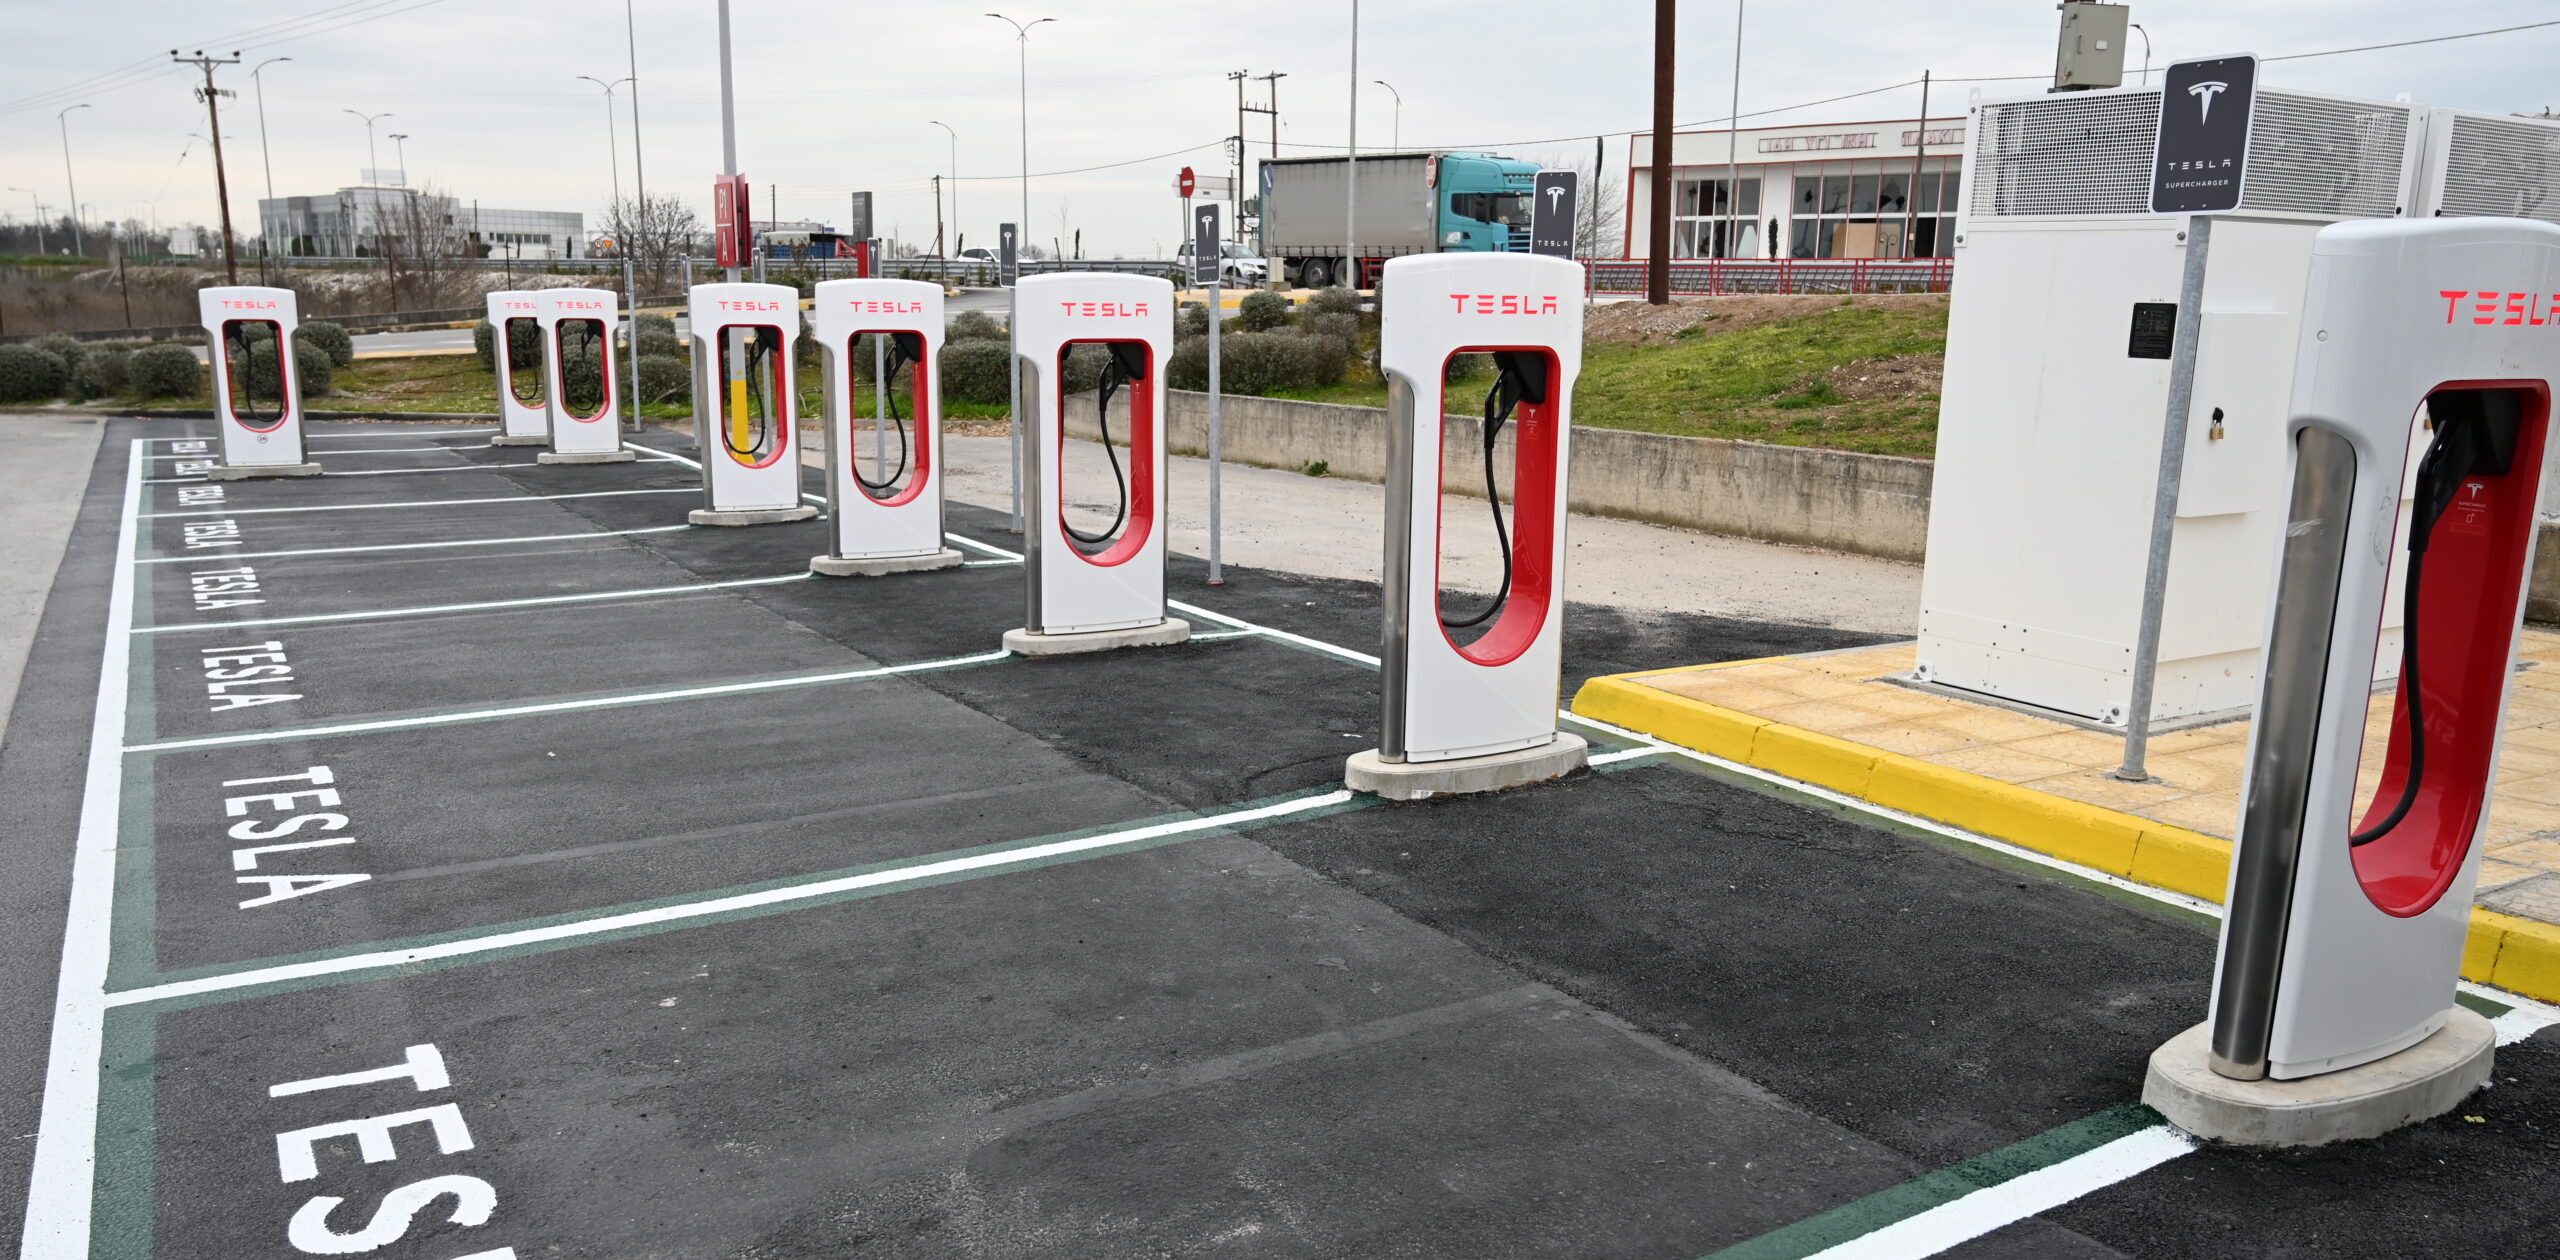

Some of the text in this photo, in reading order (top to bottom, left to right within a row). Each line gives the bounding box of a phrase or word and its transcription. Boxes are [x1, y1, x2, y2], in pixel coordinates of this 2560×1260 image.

[2168, 159, 2231, 171] TESLA
[2165, 179, 2229, 189] SUPERCHARGER
[221, 300, 277, 309] TESLA
[555, 301, 602, 309] TESLA
[718, 301, 779, 311] TESLA
[850, 301, 922, 313] TESLA
[1060, 302, 1148, 317] TESLA
[1449, 294, 1557, 315] TESLA
[184, 520, 243, 549] TESLA
[191, 567, 266, 611] TESLA
[201, 641, 304, 712] TESLA
[223, 765, 372, 910] TESLA
[269, 1043, 518, 1260] TES
